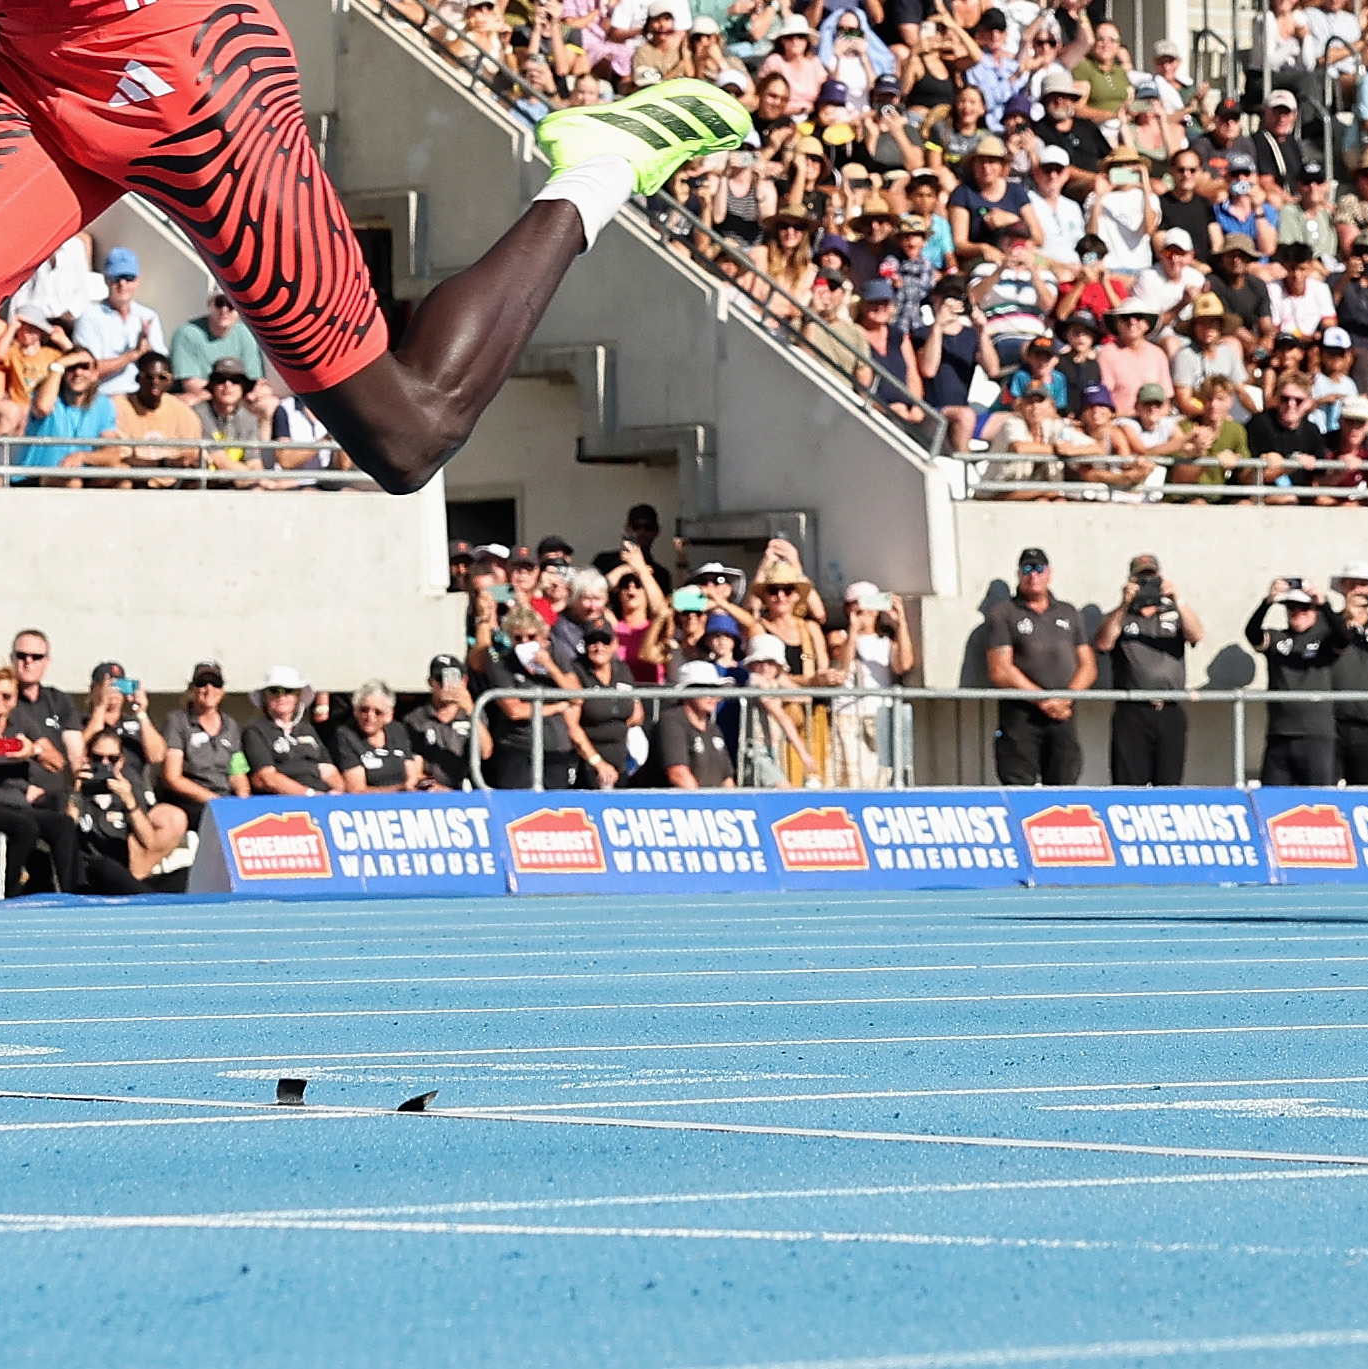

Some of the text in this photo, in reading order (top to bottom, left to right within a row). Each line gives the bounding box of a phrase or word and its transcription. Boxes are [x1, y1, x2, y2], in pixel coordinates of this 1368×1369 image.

[328, 807, 490, 850] CHEMIST
[602, 808, 761, 848] CHEMIST
[861, 806, 1012, 845] CHEMIST
[1107, 804, 1251, 842] CHEMIST
[237, 834, 319, 857] CHEMIST
[515, 830, 594, 851] CHEMIST
[338, 852, 496, 877] WAREHOUSE
[612, 850, 767, 873] WAREHOUSE
[874, 847, 1019, 870] WAREHOUSE
[1120, 844, 1259, 867] WAREHOUSE
